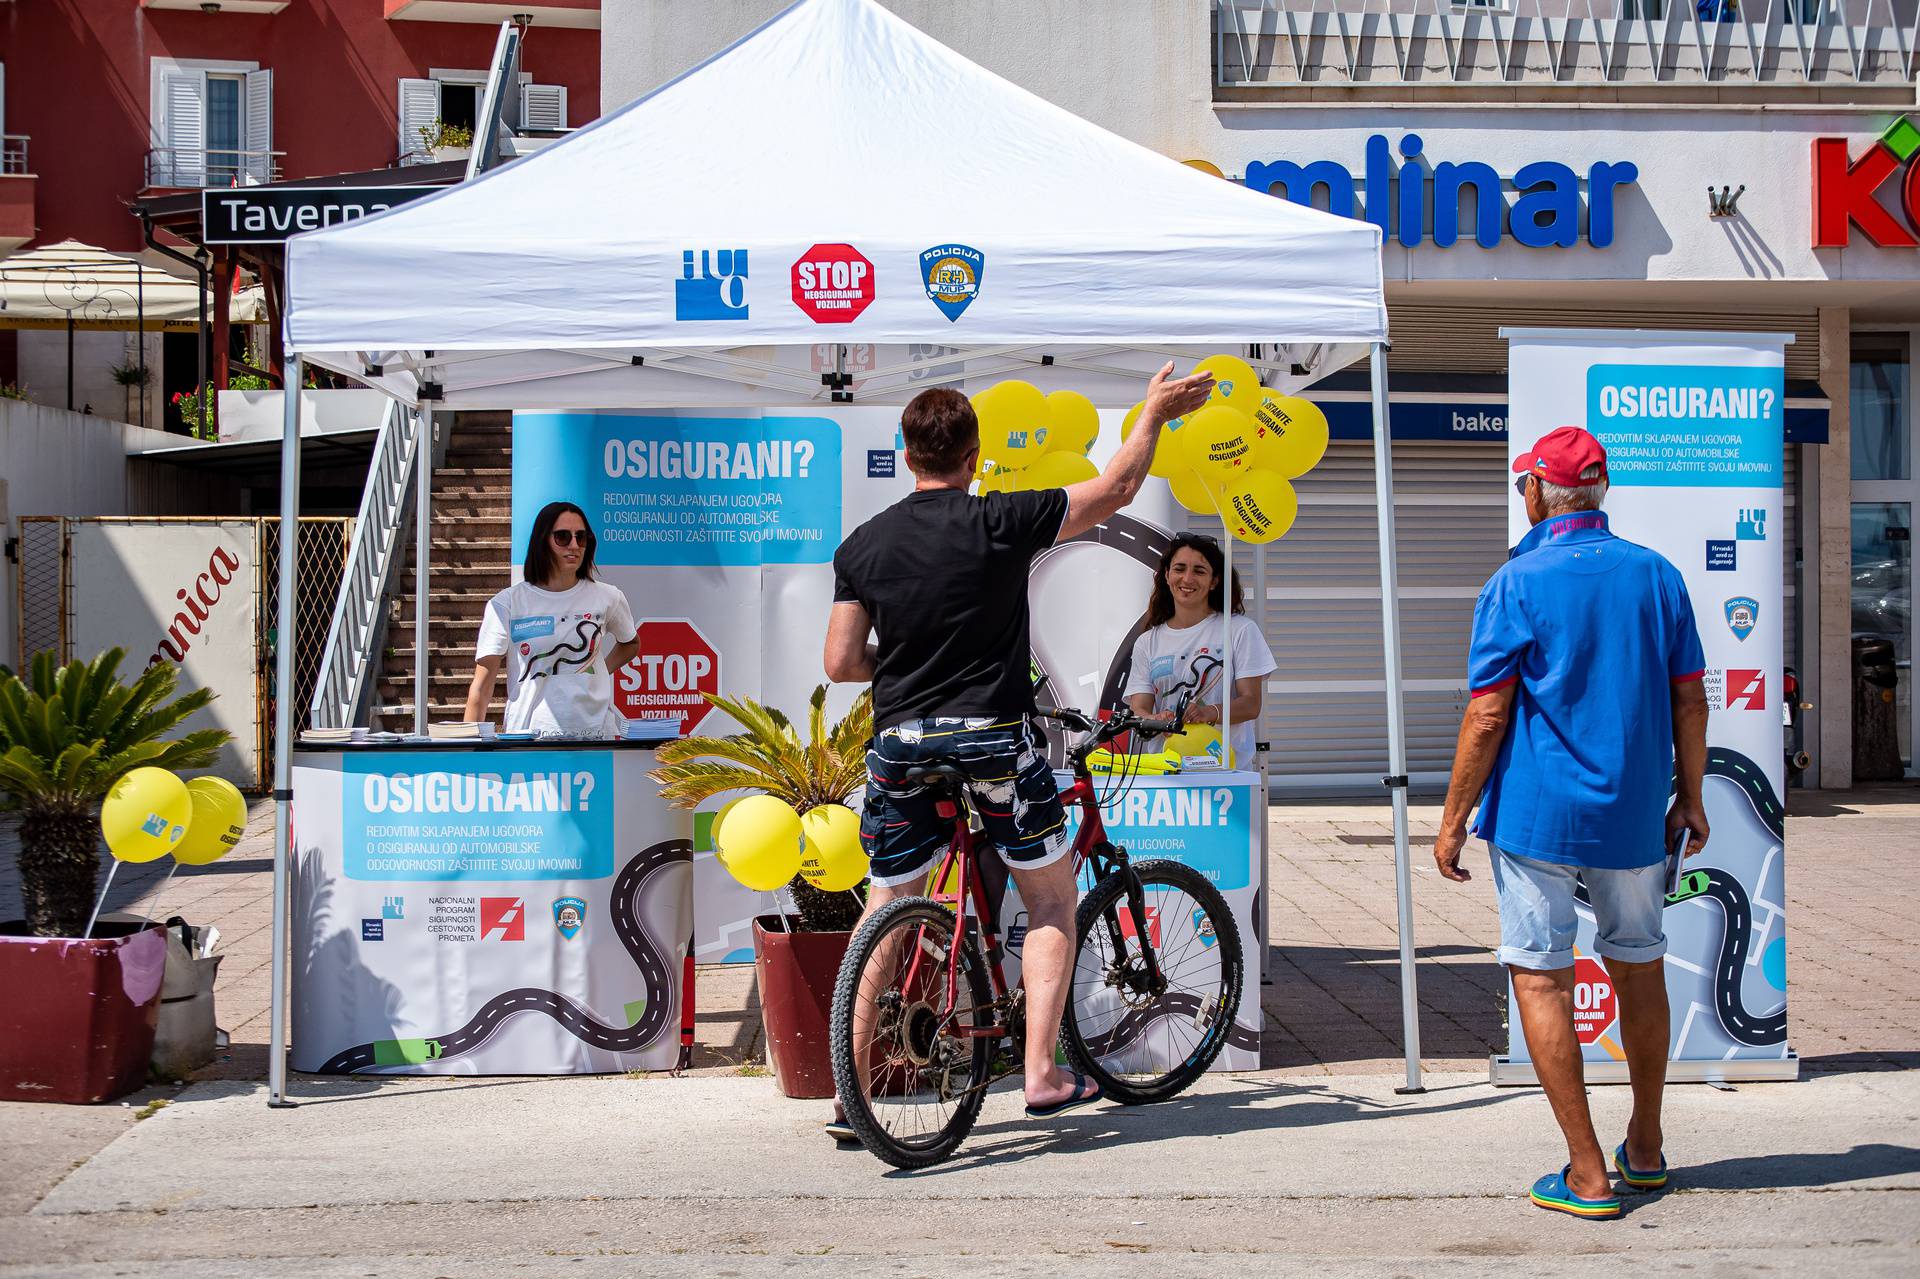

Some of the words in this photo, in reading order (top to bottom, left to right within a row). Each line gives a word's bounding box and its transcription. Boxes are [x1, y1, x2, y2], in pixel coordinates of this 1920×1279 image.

[1811, 137, 1920, 248] K
[923, 247, 981, 261] POLICIJA
[799, 261, 867, 290] STOP
[804, 290, 863, 300] NEOSIGURANIM
[938, 285, 966, 293] MUP
[815, 300, 852, 309] VOZILIMA
[1600, 385, 1775, 419] OSIGURANI?
[1211, 436, 1244, 451] OSTANITE
[1597, 433, 1643, 444] REDOVITIM
[1644, 433, 1700, 444] SKLAPANJEM
[1701, 435, 1743, 445] UGOVORA
[604, 439, 815, 480] OSIGURANI?
[1208, 444, 1250, 461] OSIGURANI!
[1606, 447, 1660, 457] OSIGURANJU
[1661, 447, 1674, 457] OD
[1675, 448, 1740, 459] AUTOMOBILSKE
[1605, 461, 1664, 471] GOVORNOSTI
[1665, 460, 1706, 472] ZAŠTITITE
[1707, 462, 1736, 472] SVOJU
[1737, 462, 1772, 473] IMOVINU
[603, 493, 657, 506] REDOVITIM
[660, 494, 728, 507] SKLAPANJEM
[731, 492, 783, 507] UGOVORA
[603, 511, 611, 523] O
[614, 511, 677, 525] OSIGURANJU
[680, 512, 695, 524] OD
[699, 510, 780, 525] AUTOMOBILSKE
[1232, 495, 1266, 537] OSIGURANI!
[1243, 493, 1272, 529] OSTANITE
[603, 529, 683, 542] ODGOVORNOSTI
[685, 528, 736, 543] ZAŠTITITE
[739, 529, 774, 543] SVOJU
[776, 528, 823, 541] IMOVINU
[142, 545, 240, 674] nica
[619, 653, 711, 692] STOP
[626, 694, 704, 706] NEOSIGURANIM
[640, 710, 689, 721] VOZILIMA
[363, 771, 596, 814] OSIGURANI?
[366, 826, 419, 838] REDOVITIM
[422, 825, 489, 838] SKLAPANJEM
[492, 825, 544, 837] UGOVORA
[367, 842, 375, 854] O
[378, 842, 441, 854] OSIGURANJU
[442, 843, 458, 854] OD
[460, 842, 541, 854] AUTOMOBILSKE
[1137, 838, 1186, 849] UGOVORA
[367, 859, 446, 871] ODGOVORNOSTI
[448, 857, 498, 871] ZAŠTITITE
[501, 858, 535, 871] SVOJU
[537, 858, 582, 870] IMOVINU
[427, 925, 476, 933] CESTOVNOG
[1574, 982, 1611, 1010] OP
[1573, 1011, 1606, 1021] URANIM
[1574, 1023, 1594, 1032] LIMA
